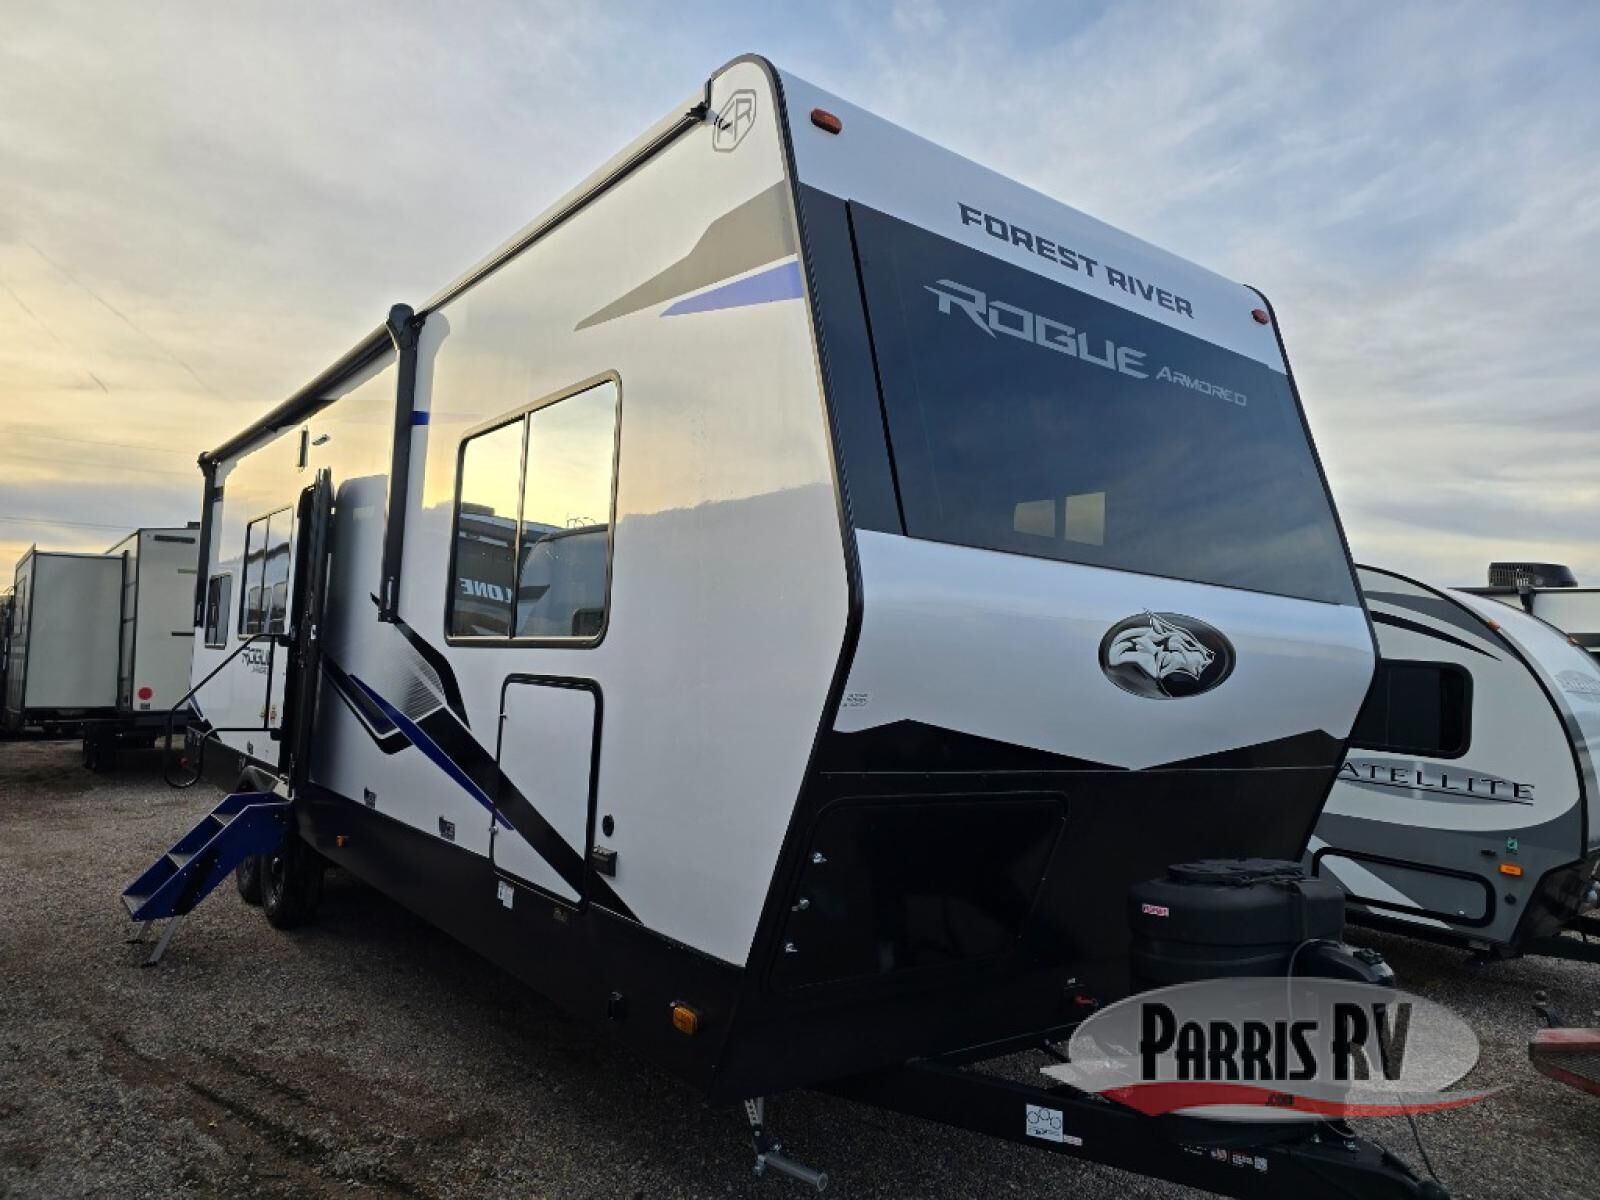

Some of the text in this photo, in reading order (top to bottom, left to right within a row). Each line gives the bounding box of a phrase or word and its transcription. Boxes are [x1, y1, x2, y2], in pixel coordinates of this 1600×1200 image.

[957, 202, 1195, 320] FOREST RIVER
[923, 279, 1248, 407] ROGUE ARMORED
[1337, 761, 1536, 801] ATELLITE
